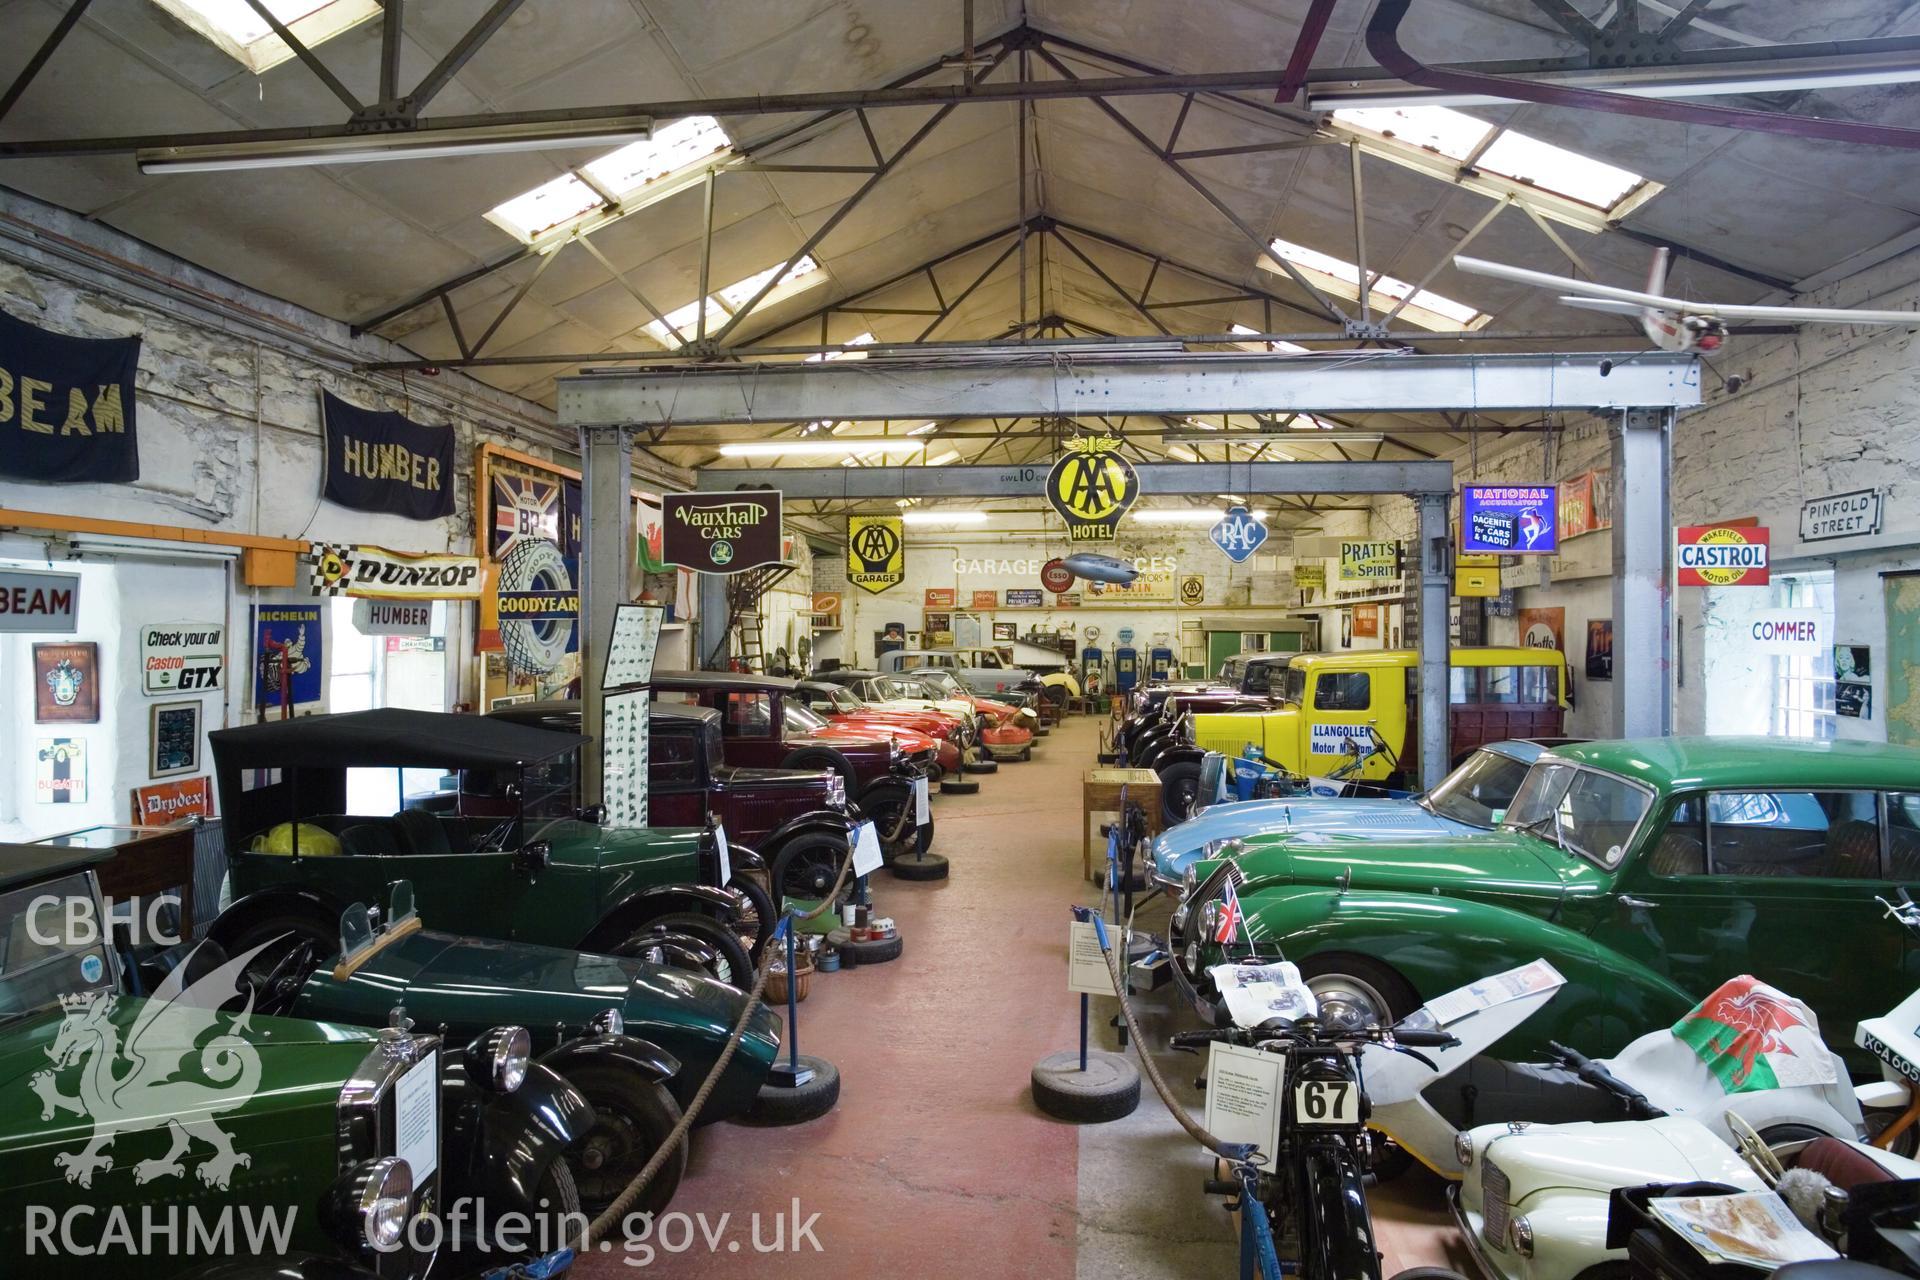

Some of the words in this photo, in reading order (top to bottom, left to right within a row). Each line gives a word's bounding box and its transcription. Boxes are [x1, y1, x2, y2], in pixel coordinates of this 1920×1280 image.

[343, 434, 441, 491] HUMBER
[1019, 469, 1034, 482] 10
[1065, 457, 1120, 513] AA
[1473, 488, 1548, 499] NATIONAL
[520, 496, 537, 507] MOTOR
[1810, 497, 1869, 519] PINFOLD
[519, 509, 539, 536] BP
[675, 503, 768, 526] Vauxhall
[1473, 515, 1511, 528] DAGENITE
[701, 527, 742, 539] CARS
[1073, 524, 1113, 538] HOTEL
[1221, 516, 1256, 550] RAC
[1474, 526, 1484, 534] for
[1487, 528, 1510, 538] CARS
[1812, 516, 1863, 535] STREET
[863, 527, 891, 560] AA
[1474, 533, 1480, 541] &
[1482, 535, 1509, 546] RADIO
[1702, 529, 1743, 543] WAKEFIELD
[1342, 542, 1395, 565] PRATT'S
[1682, 547, 1763, 566] CASTROL
[355, 560, 477, 587] DUNLOP
[953, 558, 1039, 575] GARAGE
[1358, 565, 1395, 577] SPIRIT
[856, 574, 895, 583] GARAGE
[1702, 570, 1730, 583] MOTOR
[1731, 569, 1744, 579] OIL
[498, 597, 578, 613] GOODYEAR
[258, 611, 317, 621] MICHELIN
[370, 606, 428, 626] HUMBER
[147, 631, 182, 646] Check
[182, 633, 207, 647] your
[207, 630, 221, 645] oil
[1753, 620, 1816, 641] COMMER
[146, 656, 185, 670] Castrol
[178, 667, 222, 690] GTX
[1314, 725, 1371, 737] LLANGOLLEN
[1312, 742, 1335, 753] Motor
[1340, 743, 1372, 754] Mum
[38, 779, 84, 790] BUGATTI
[148, 792, 202, 813] Drydex
[1865, 1033, 1890, 1063] XCA
[1891, 1054, 1920, 1082] 605
[1304, 1081, 1349, 1119] 67
